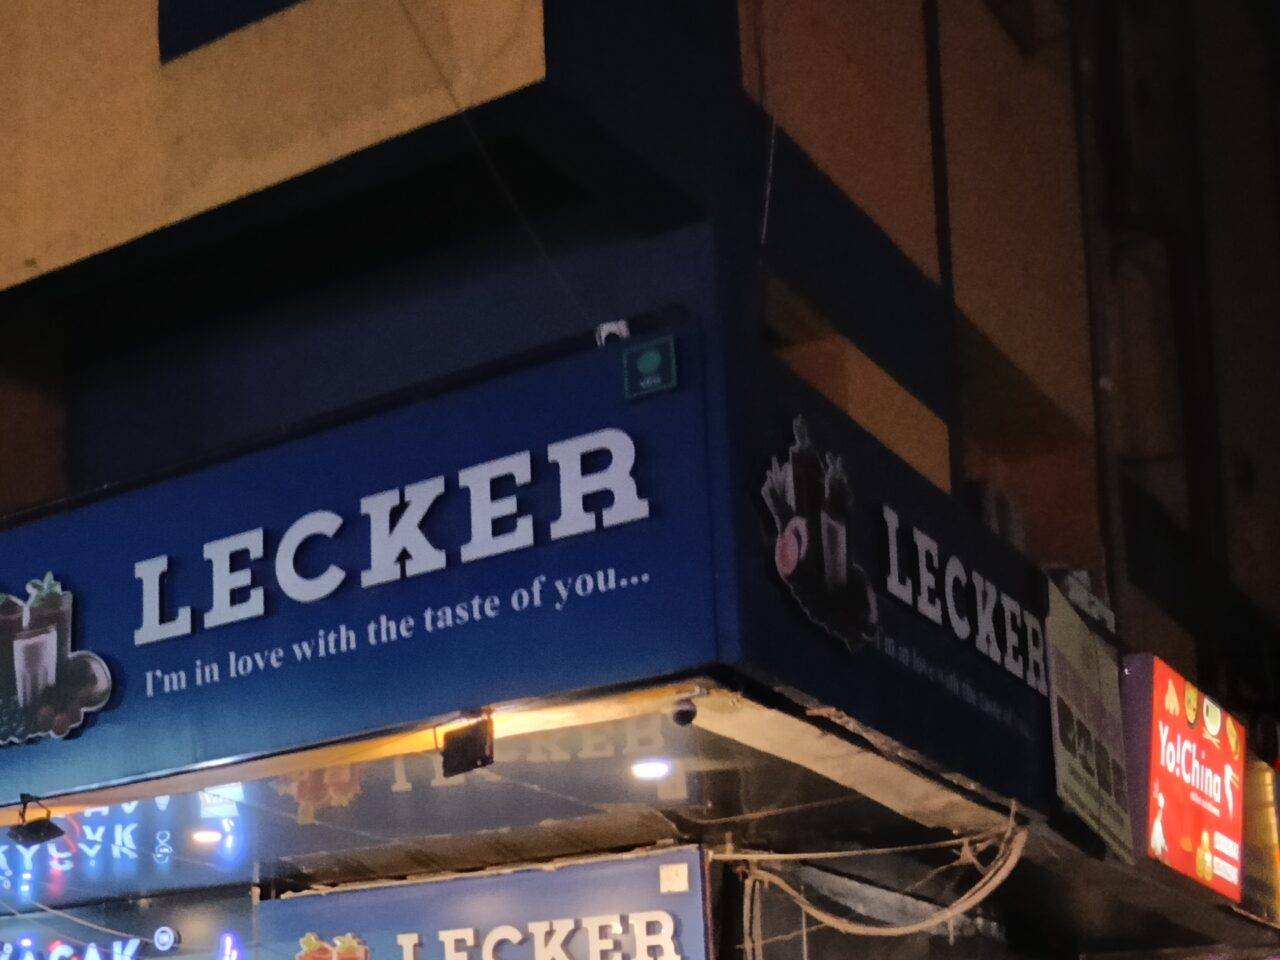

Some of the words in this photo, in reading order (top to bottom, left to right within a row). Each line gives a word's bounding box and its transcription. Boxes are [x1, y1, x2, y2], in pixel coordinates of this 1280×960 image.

[133, 427, 650, 647] LECKER
[882, 503, 1048, 697] LECKER
[143, 667, 188, 699] I'm
[194, 659, 221, 688] in
[228, 644, 284, 680] love
[293, 625, 357, 663] with
[367, 612, 415, 648] the
[423, 594, 501, 633] taste
[510, 576, 548, 612] of
[1157, 720, 1222, 804] Yo!China
